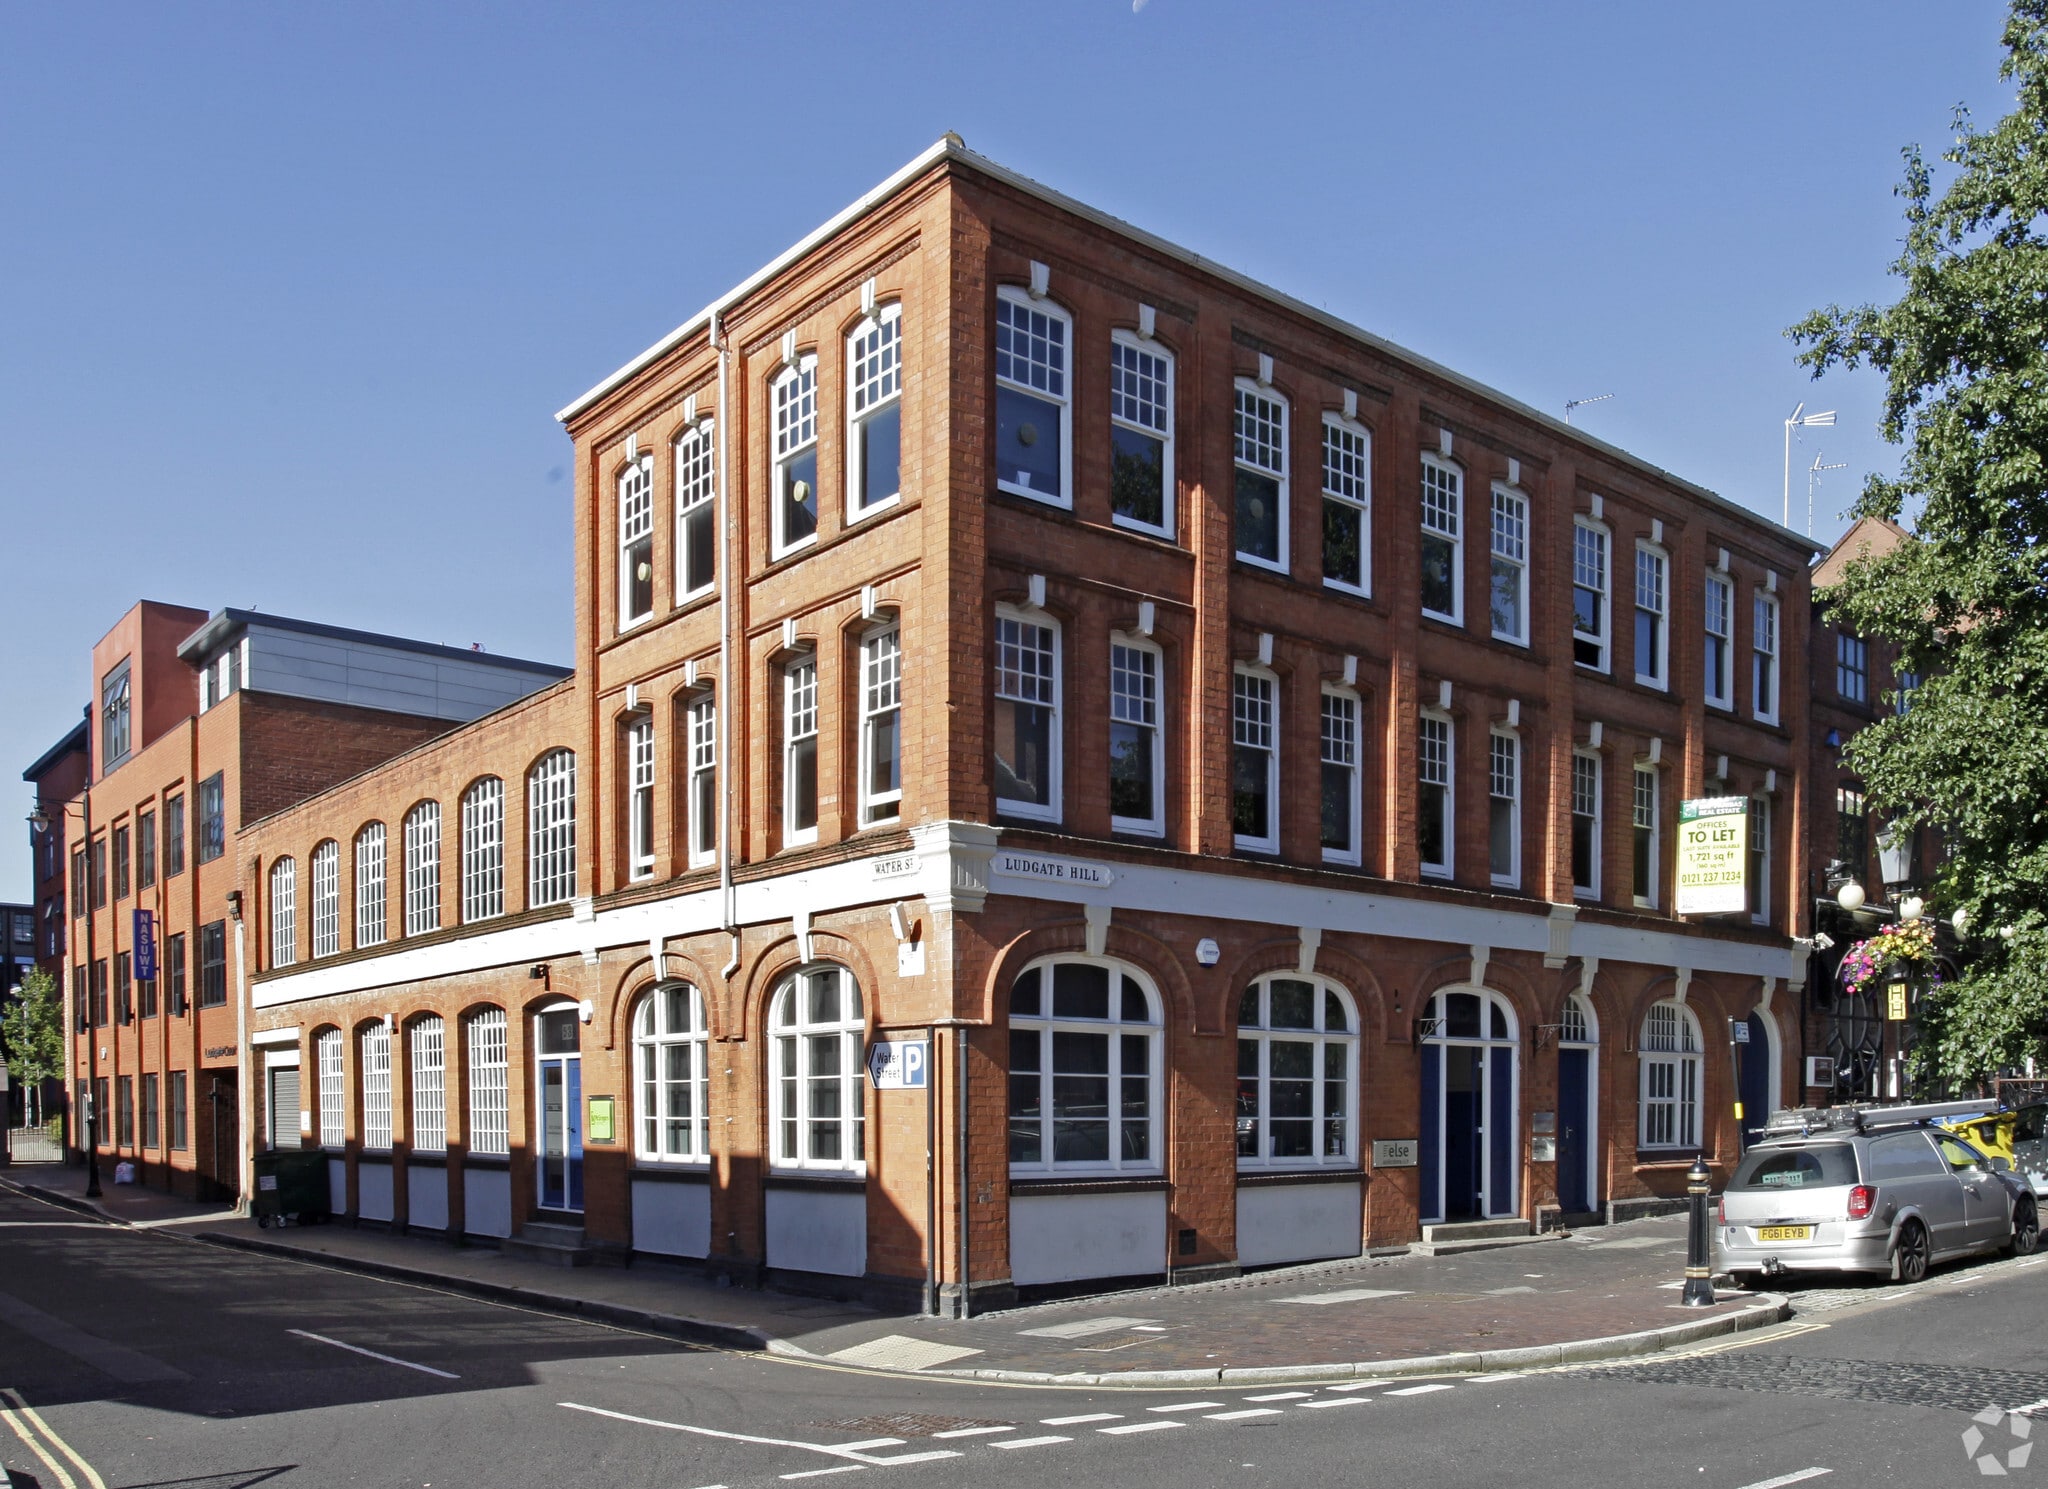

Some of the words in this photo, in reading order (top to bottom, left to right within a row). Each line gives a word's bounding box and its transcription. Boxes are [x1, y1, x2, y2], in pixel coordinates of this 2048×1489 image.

[1697, 821, 1727, 829] OFFICES
[1688, 831, 1707, 844] TO
[1713, 829, 1736, 842] LET
[1689, 853, 1711, 862] 1,721
[1713, 853, 1724, 861] sq
[1727, 851, 1734, 859] ft
[874, 860, 903, 875] WATER
[1005, 858, 1064, 877] LUDGATE
[1070, 867, 1100, 882] HILL
[1682, 873, 1700, 884] 0121
[1703, 872, 1719, 883] 237
[1722, 871, 1741, 881] 1234
[139, 913, 150, 977] NASUWT
[876, 1052, 899, 1064] Water
[905, 1046, 922, 1084] P
[876, 1067, 900, 1079] Street
[1388, 1143, 1409, 1158] else
[1762, 1228, 1782, 1239] FG61
[1785, 1227, 1804, 1238] EYB
